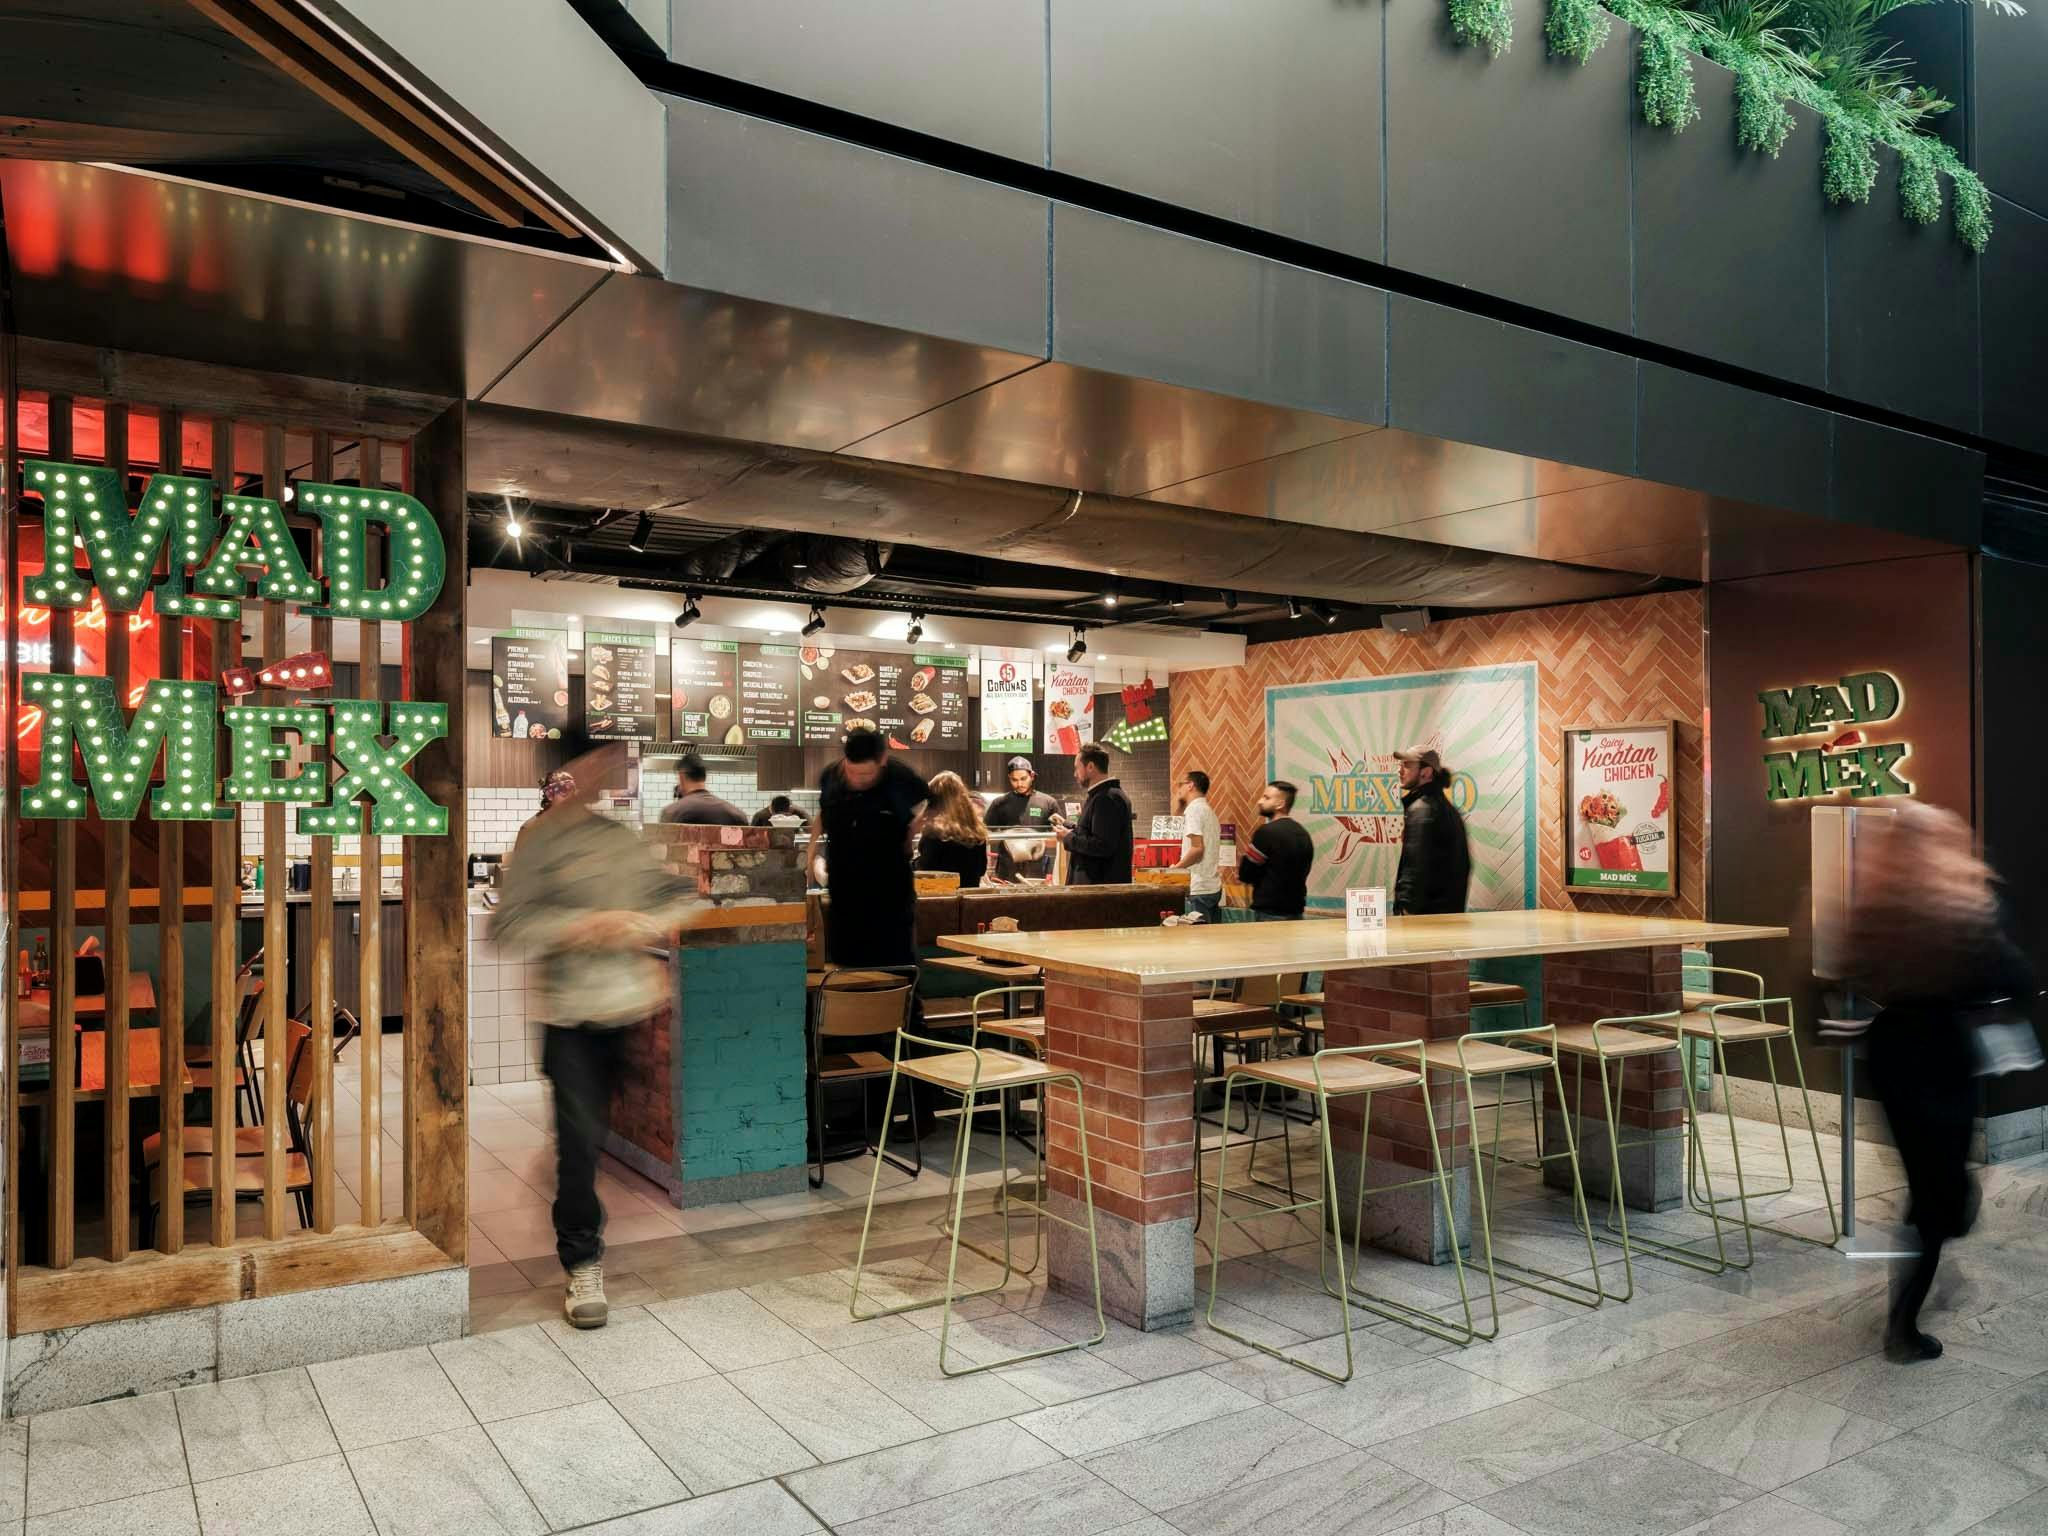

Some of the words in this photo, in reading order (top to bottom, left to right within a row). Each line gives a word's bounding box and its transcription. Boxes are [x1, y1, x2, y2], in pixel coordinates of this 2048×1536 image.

[23, 458, 446, 622] MAD
[1051, 674, 1089, 688] Yucatan
[1062, 687, 1088, 696] CHICKEN
[1757, 671, 1902, 739] MAD
[1600, 736, 1624, 750] Spicy
[1582, 743, 1658, 772] Yucatan
[1604, 763, 1654, 782] CHICKEN
[1309, 760, 1478, 817] MÉXO
[1600, 873, 1618, 881] MAD
